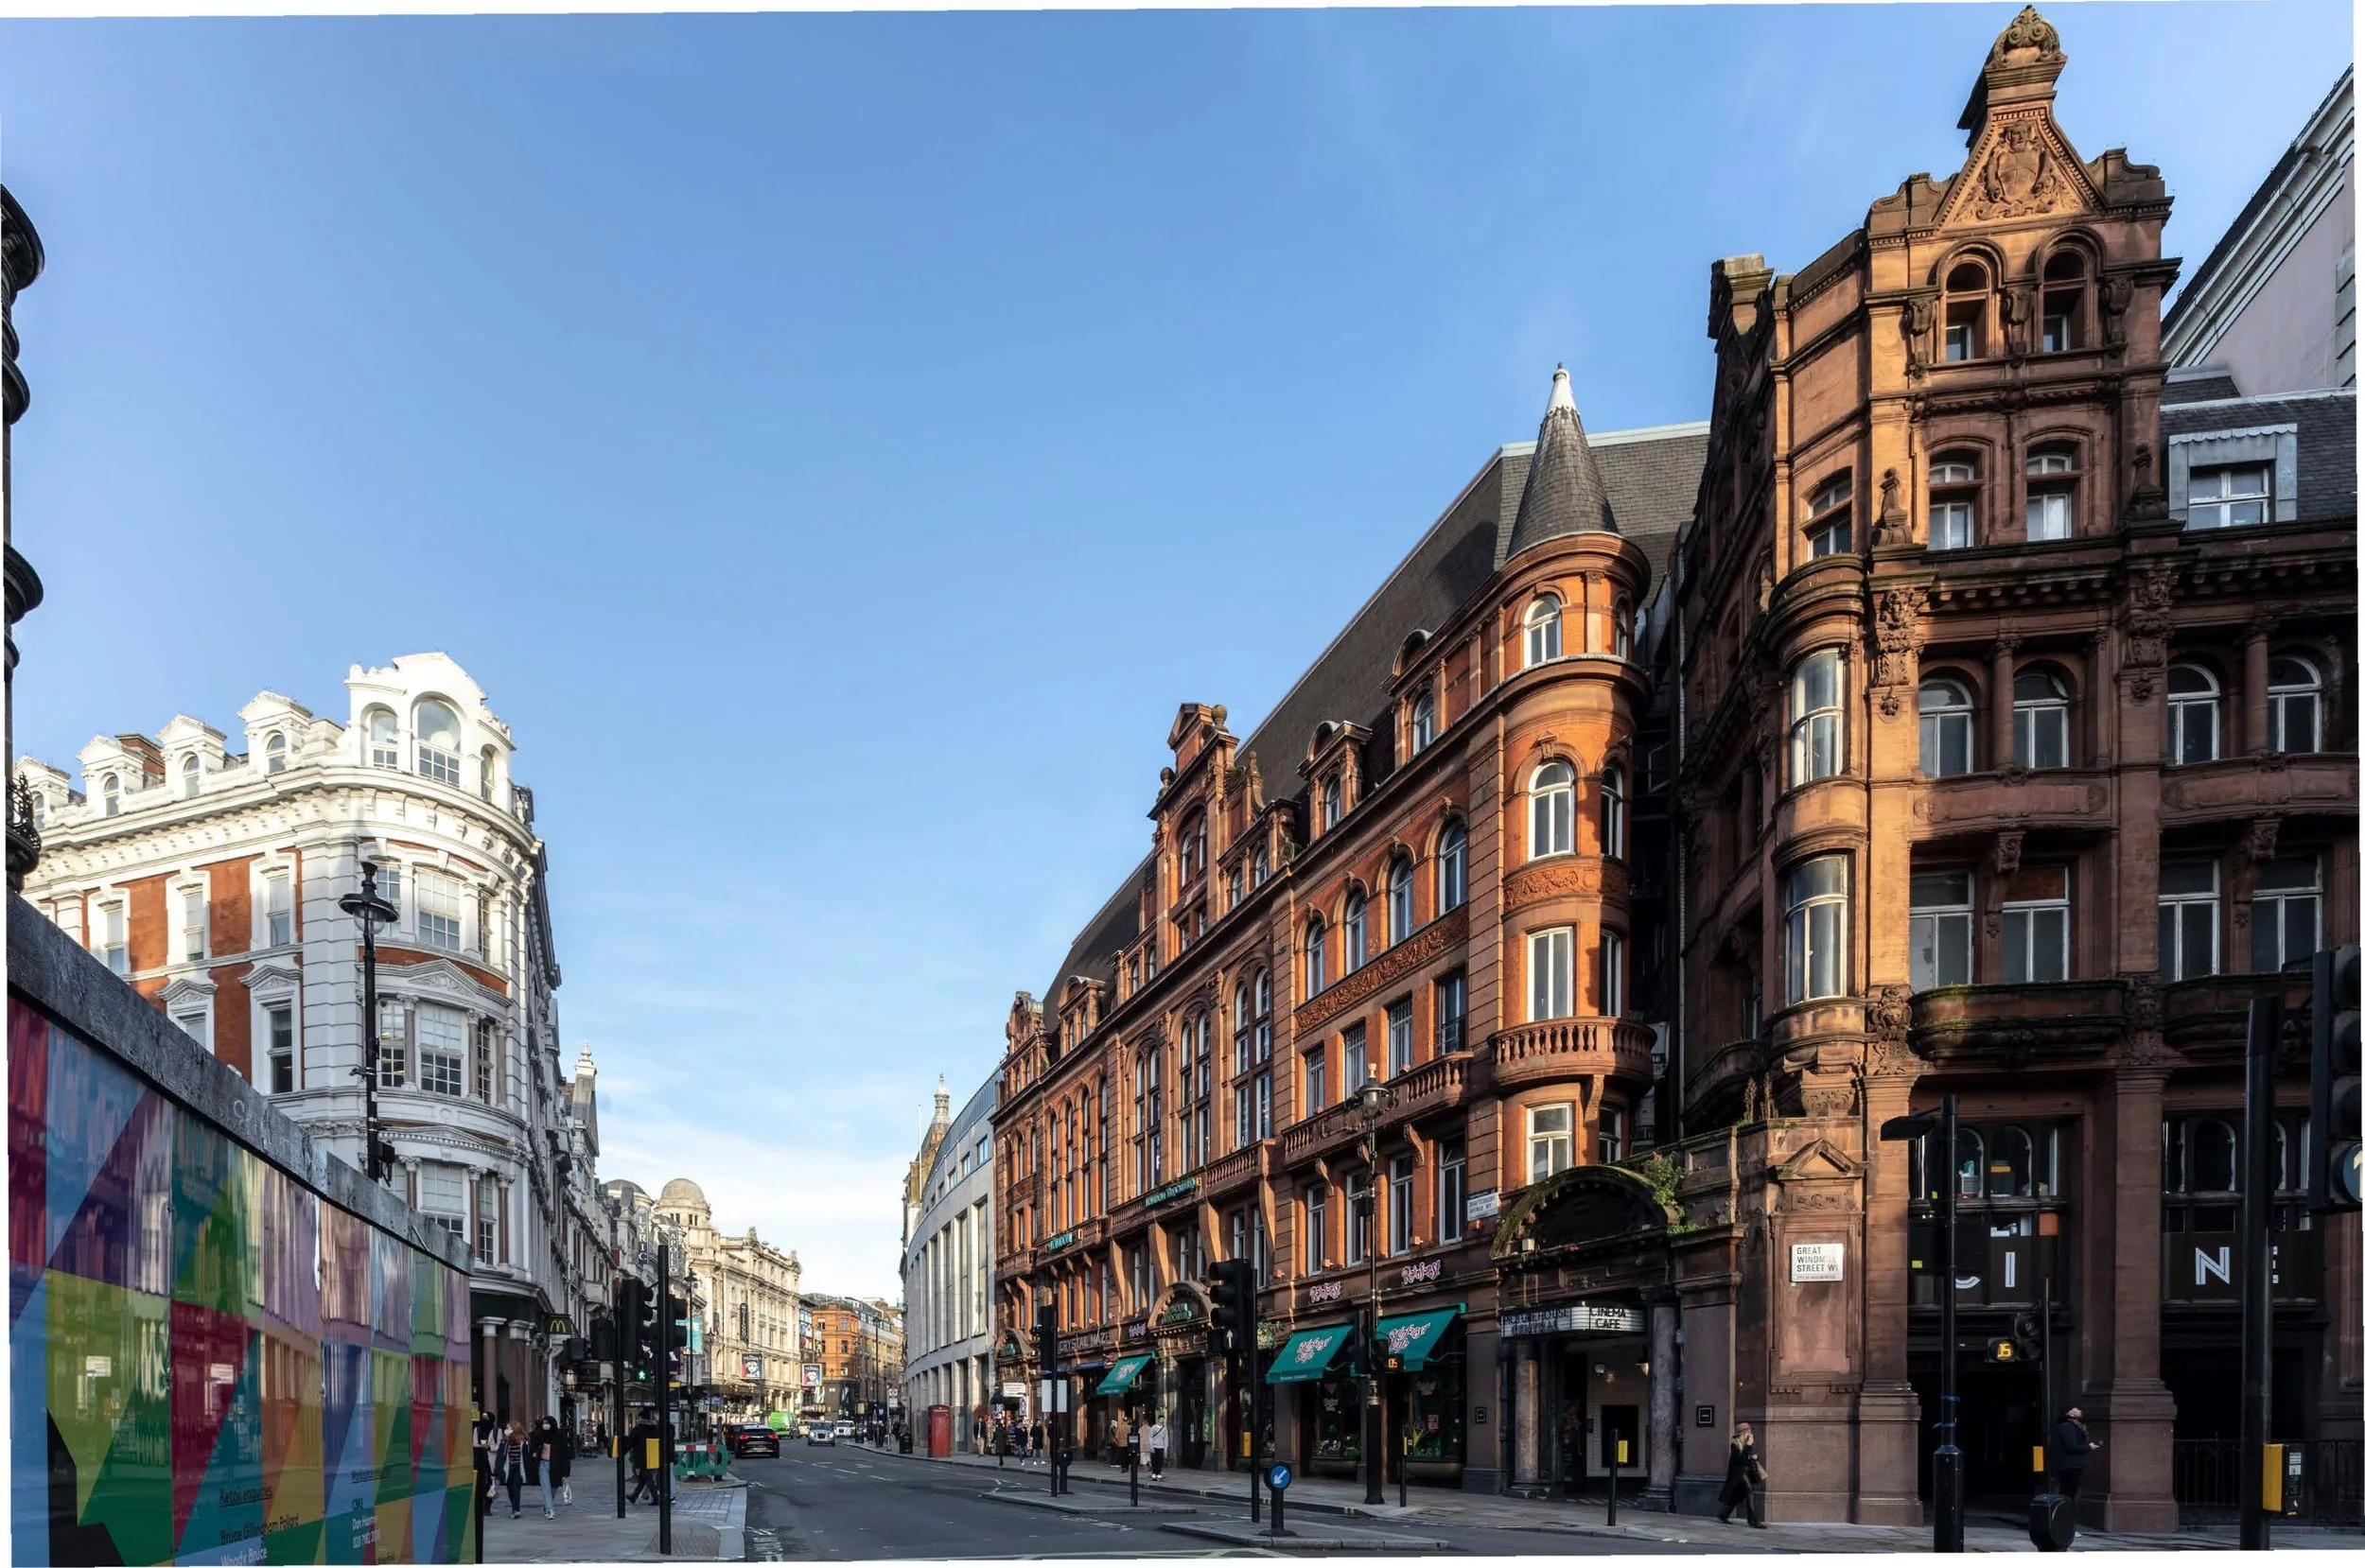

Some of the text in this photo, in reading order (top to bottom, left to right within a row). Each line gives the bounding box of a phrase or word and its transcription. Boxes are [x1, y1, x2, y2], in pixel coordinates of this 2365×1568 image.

[639, 1215, 648, 1261] LYRIC
[669, 1232, 678, 1275] APOLLO
[1796, 1246, 1821, 1255] GREAT
[1796, 1263, 1825, 1273] STREET
[1589, 1307, 1626, 1318] CINEMA
[1595, 1317, 1620, 1330] CAFE
[1059, 1332, 1112, 1352] CRYSTAL MAZE
[248, 1547, 268, 1564] Bruce
